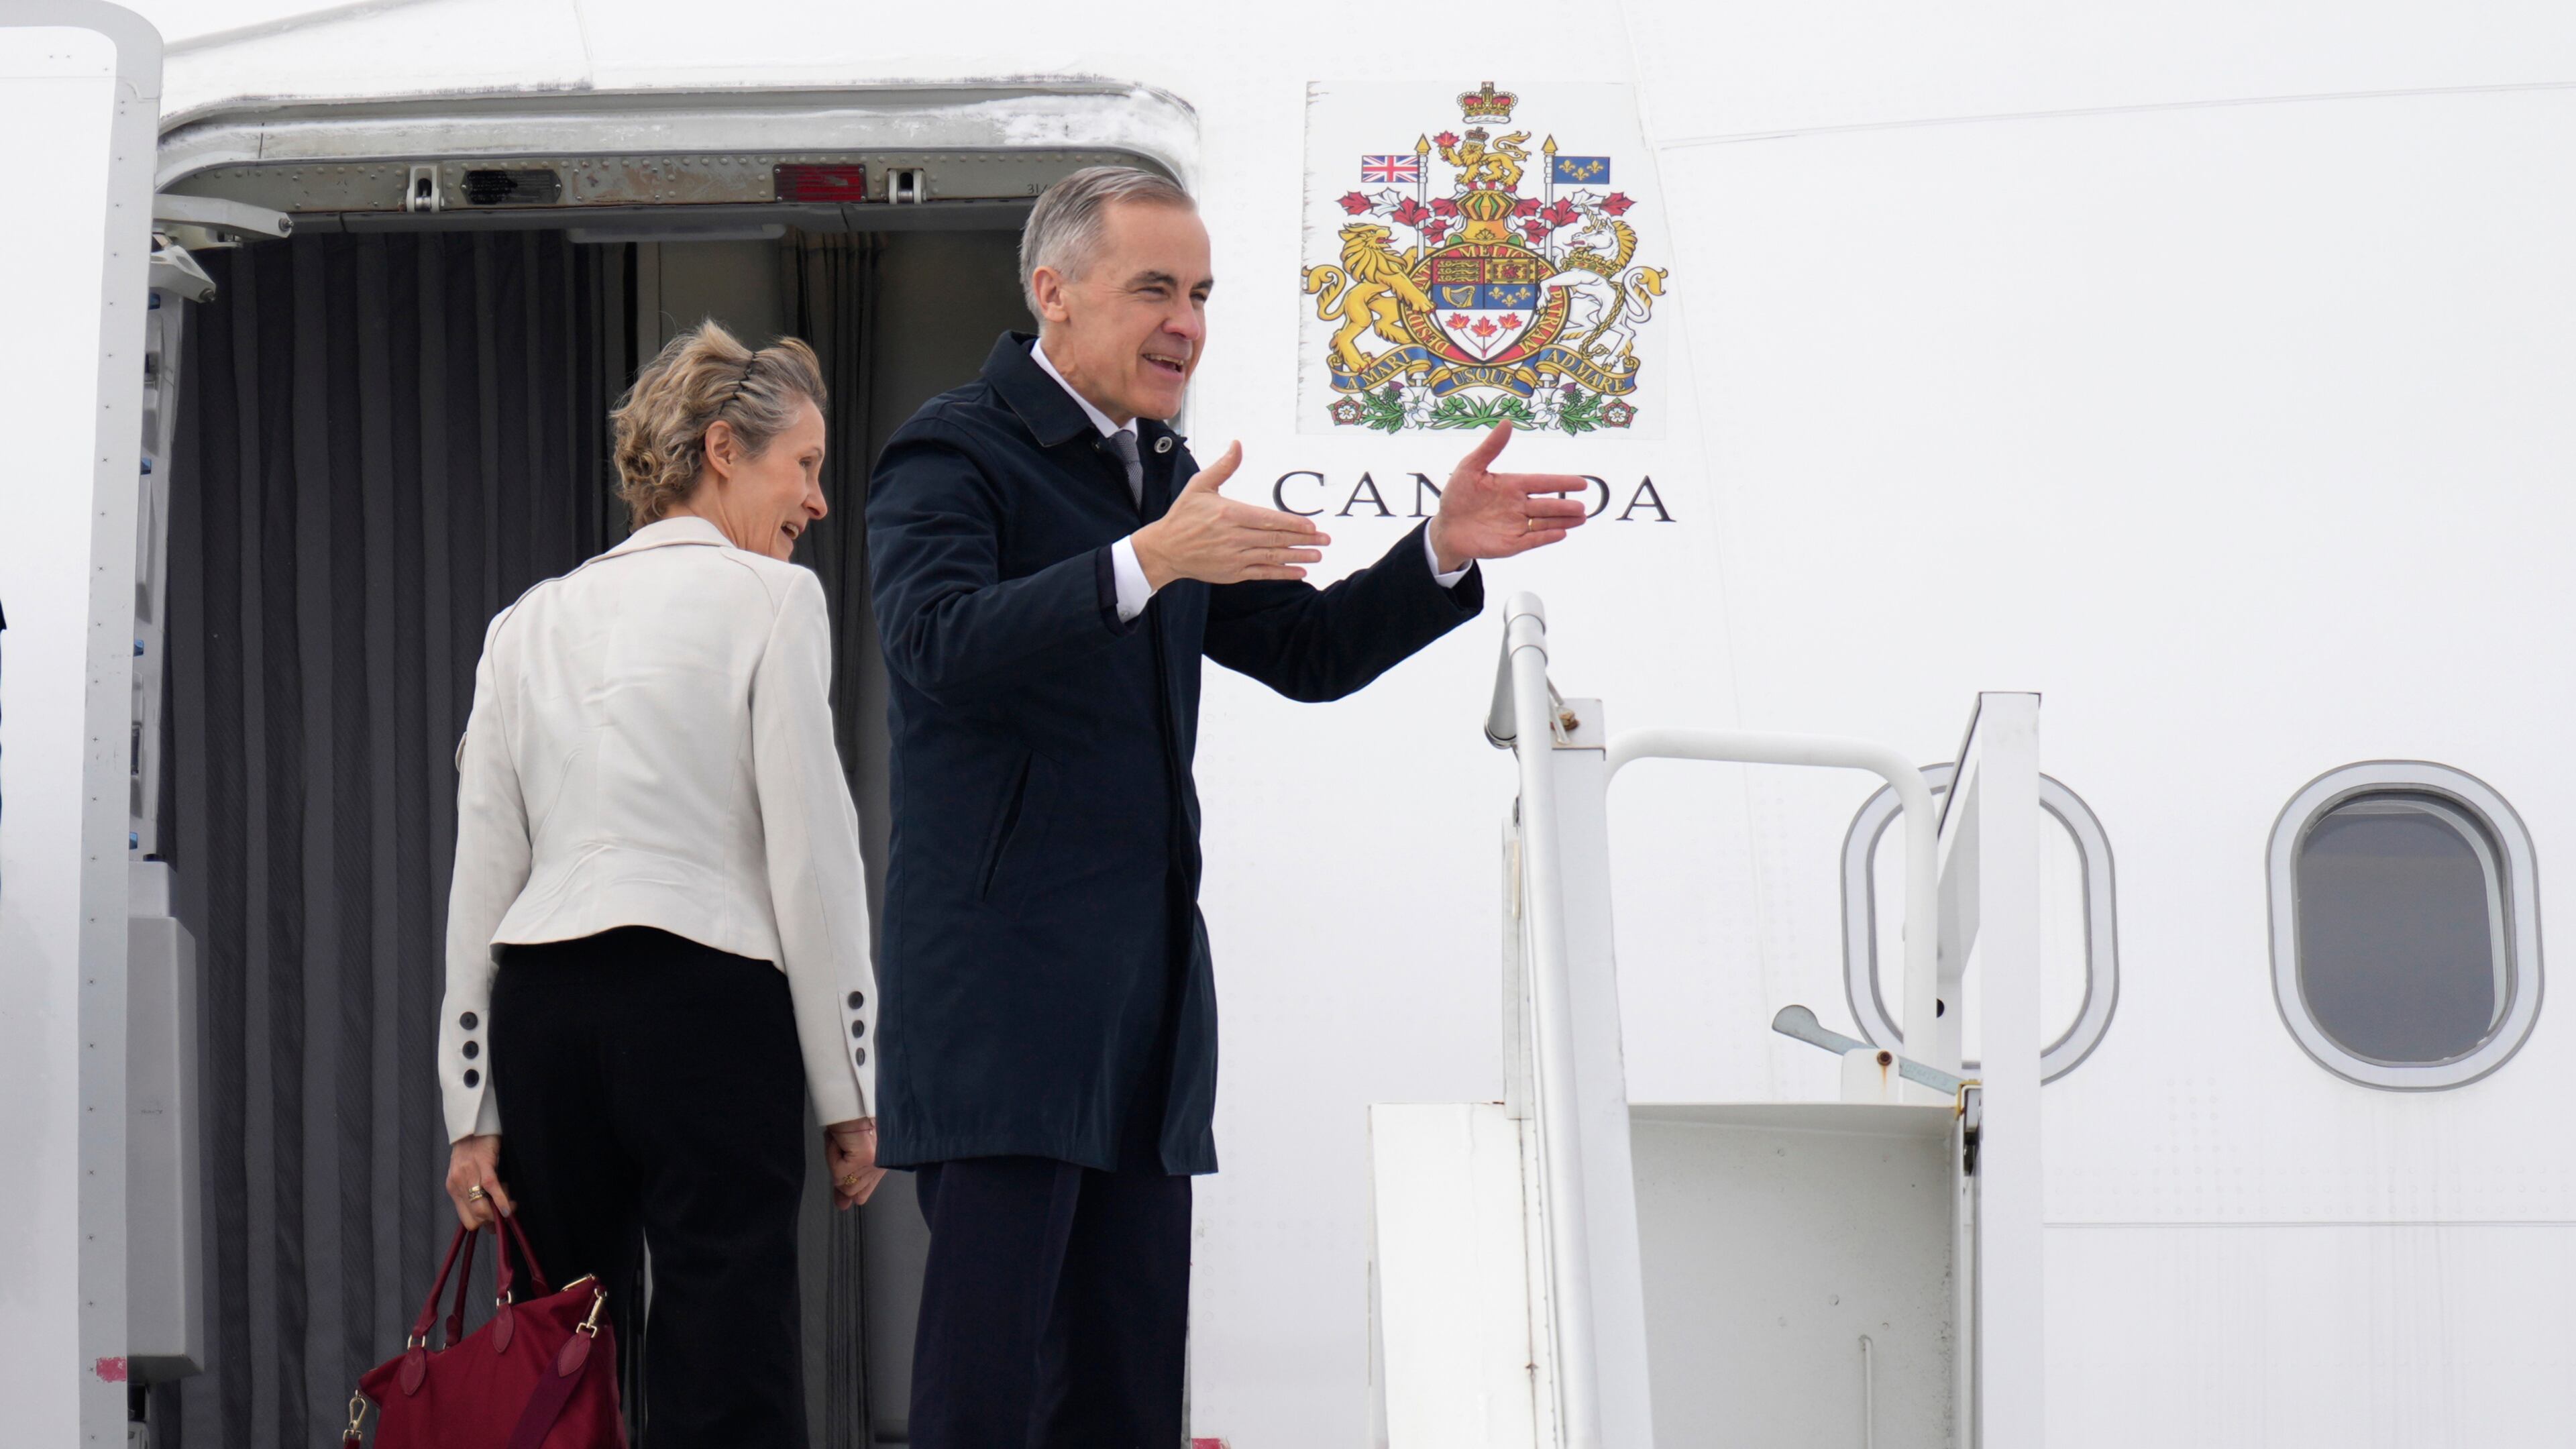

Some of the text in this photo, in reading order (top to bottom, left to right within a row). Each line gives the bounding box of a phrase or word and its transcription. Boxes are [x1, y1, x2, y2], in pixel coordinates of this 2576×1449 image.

[1518, 290, 1563, 354] PATRIAM
[1345, 349, 1626, 394] A MARI USQUE AD MARE
[1272, 470, 1677, 523] CANDA
